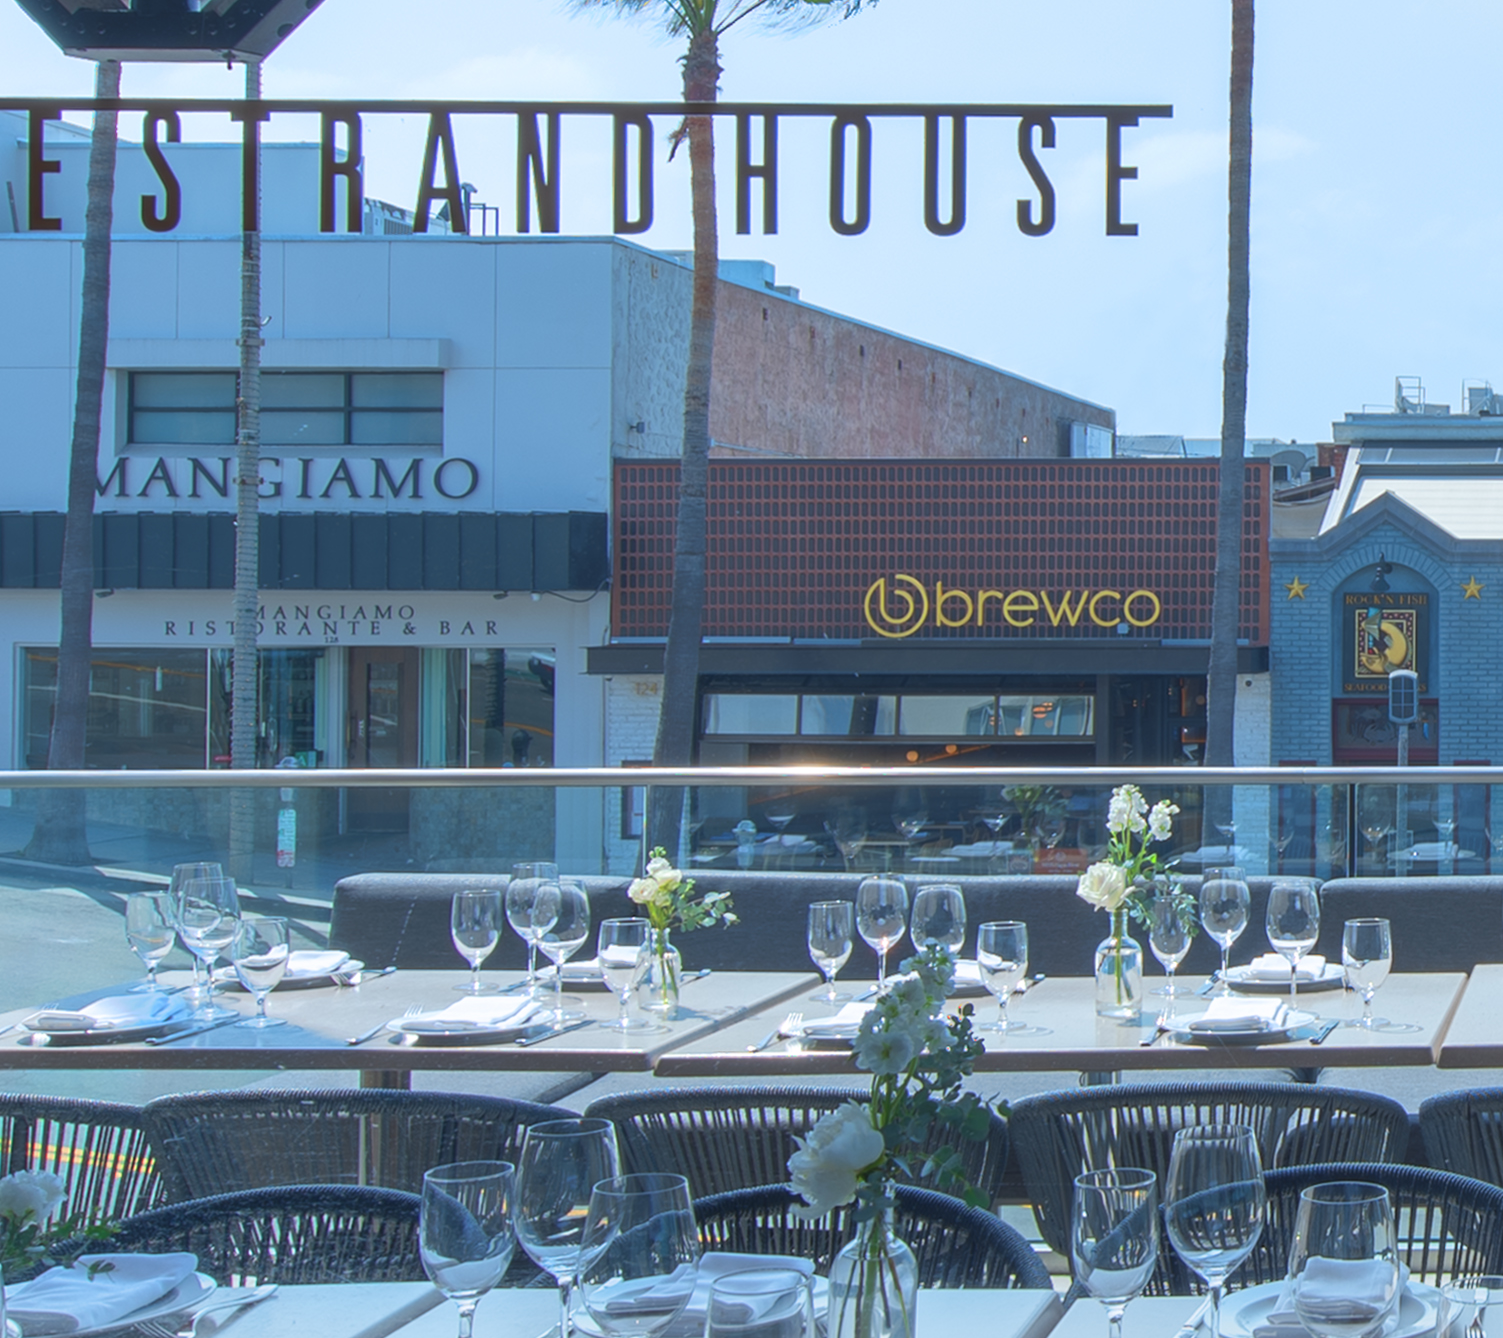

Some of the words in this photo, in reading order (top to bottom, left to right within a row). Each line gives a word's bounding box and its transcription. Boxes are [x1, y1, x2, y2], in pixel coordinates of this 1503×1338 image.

[139, 109, 655, 235] STRAND
[734, 114, 1139, 237] HOUSE
[95, 457, 479, 500] MANGIAMO
[935, 579, 1162, 628] brewco
[1399, 594, 1427, 605] FISH
[256, 605, 416, 620] MANGIAMO
[403, 622, 417, 636] &
[439, 621, 499, 636] BAR
[1345, 683, 1387, 693] SEAFOOD
